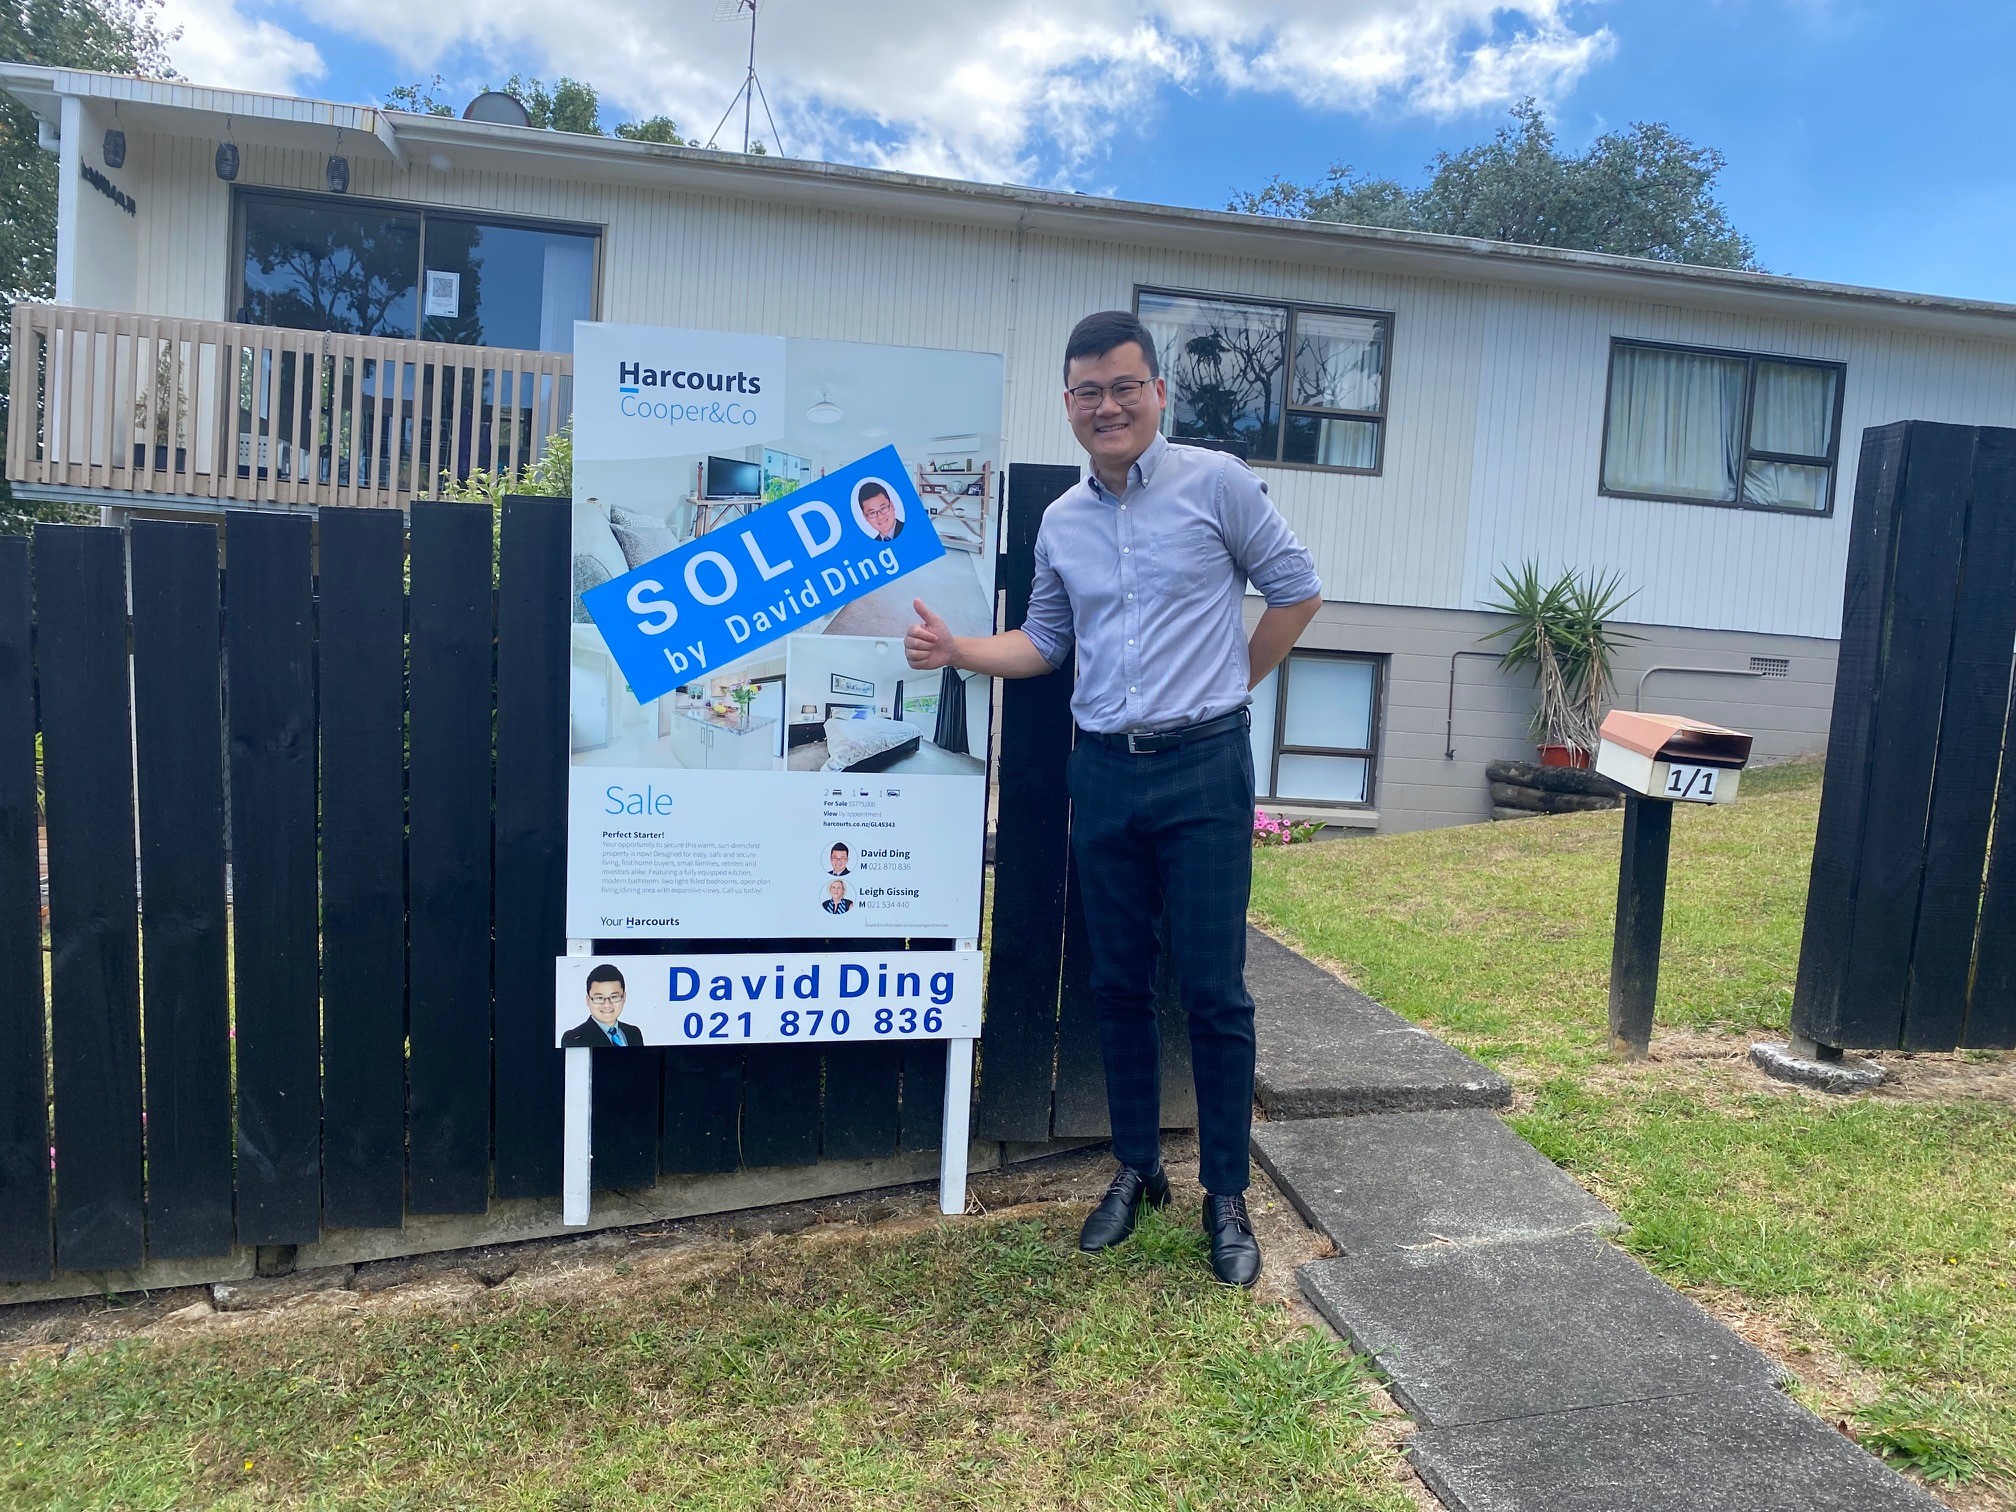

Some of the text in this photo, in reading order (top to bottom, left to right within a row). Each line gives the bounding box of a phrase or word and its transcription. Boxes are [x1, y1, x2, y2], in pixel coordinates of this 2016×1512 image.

[619, 361, 761, 394] Harcourts
[621, 395, 757, 426] Cooper&Co
[626, 500, 842, 636] SOLD
[663, 547, 900, 675] by David Ding
[1668, 768, 1713, 797] 1/1
[605, 784, 673, 815] Sale
[602, 831, 632, 839] Perfect
[861, 849, 911, 860] David Ding
[860, 887, 919, 898] Leigh Gissing
[600, 917, 680, 926] Your Harcourts
[669, 963, 954, 1004] David Ding
[683, 1007, 943, 1039] 021 870 836
